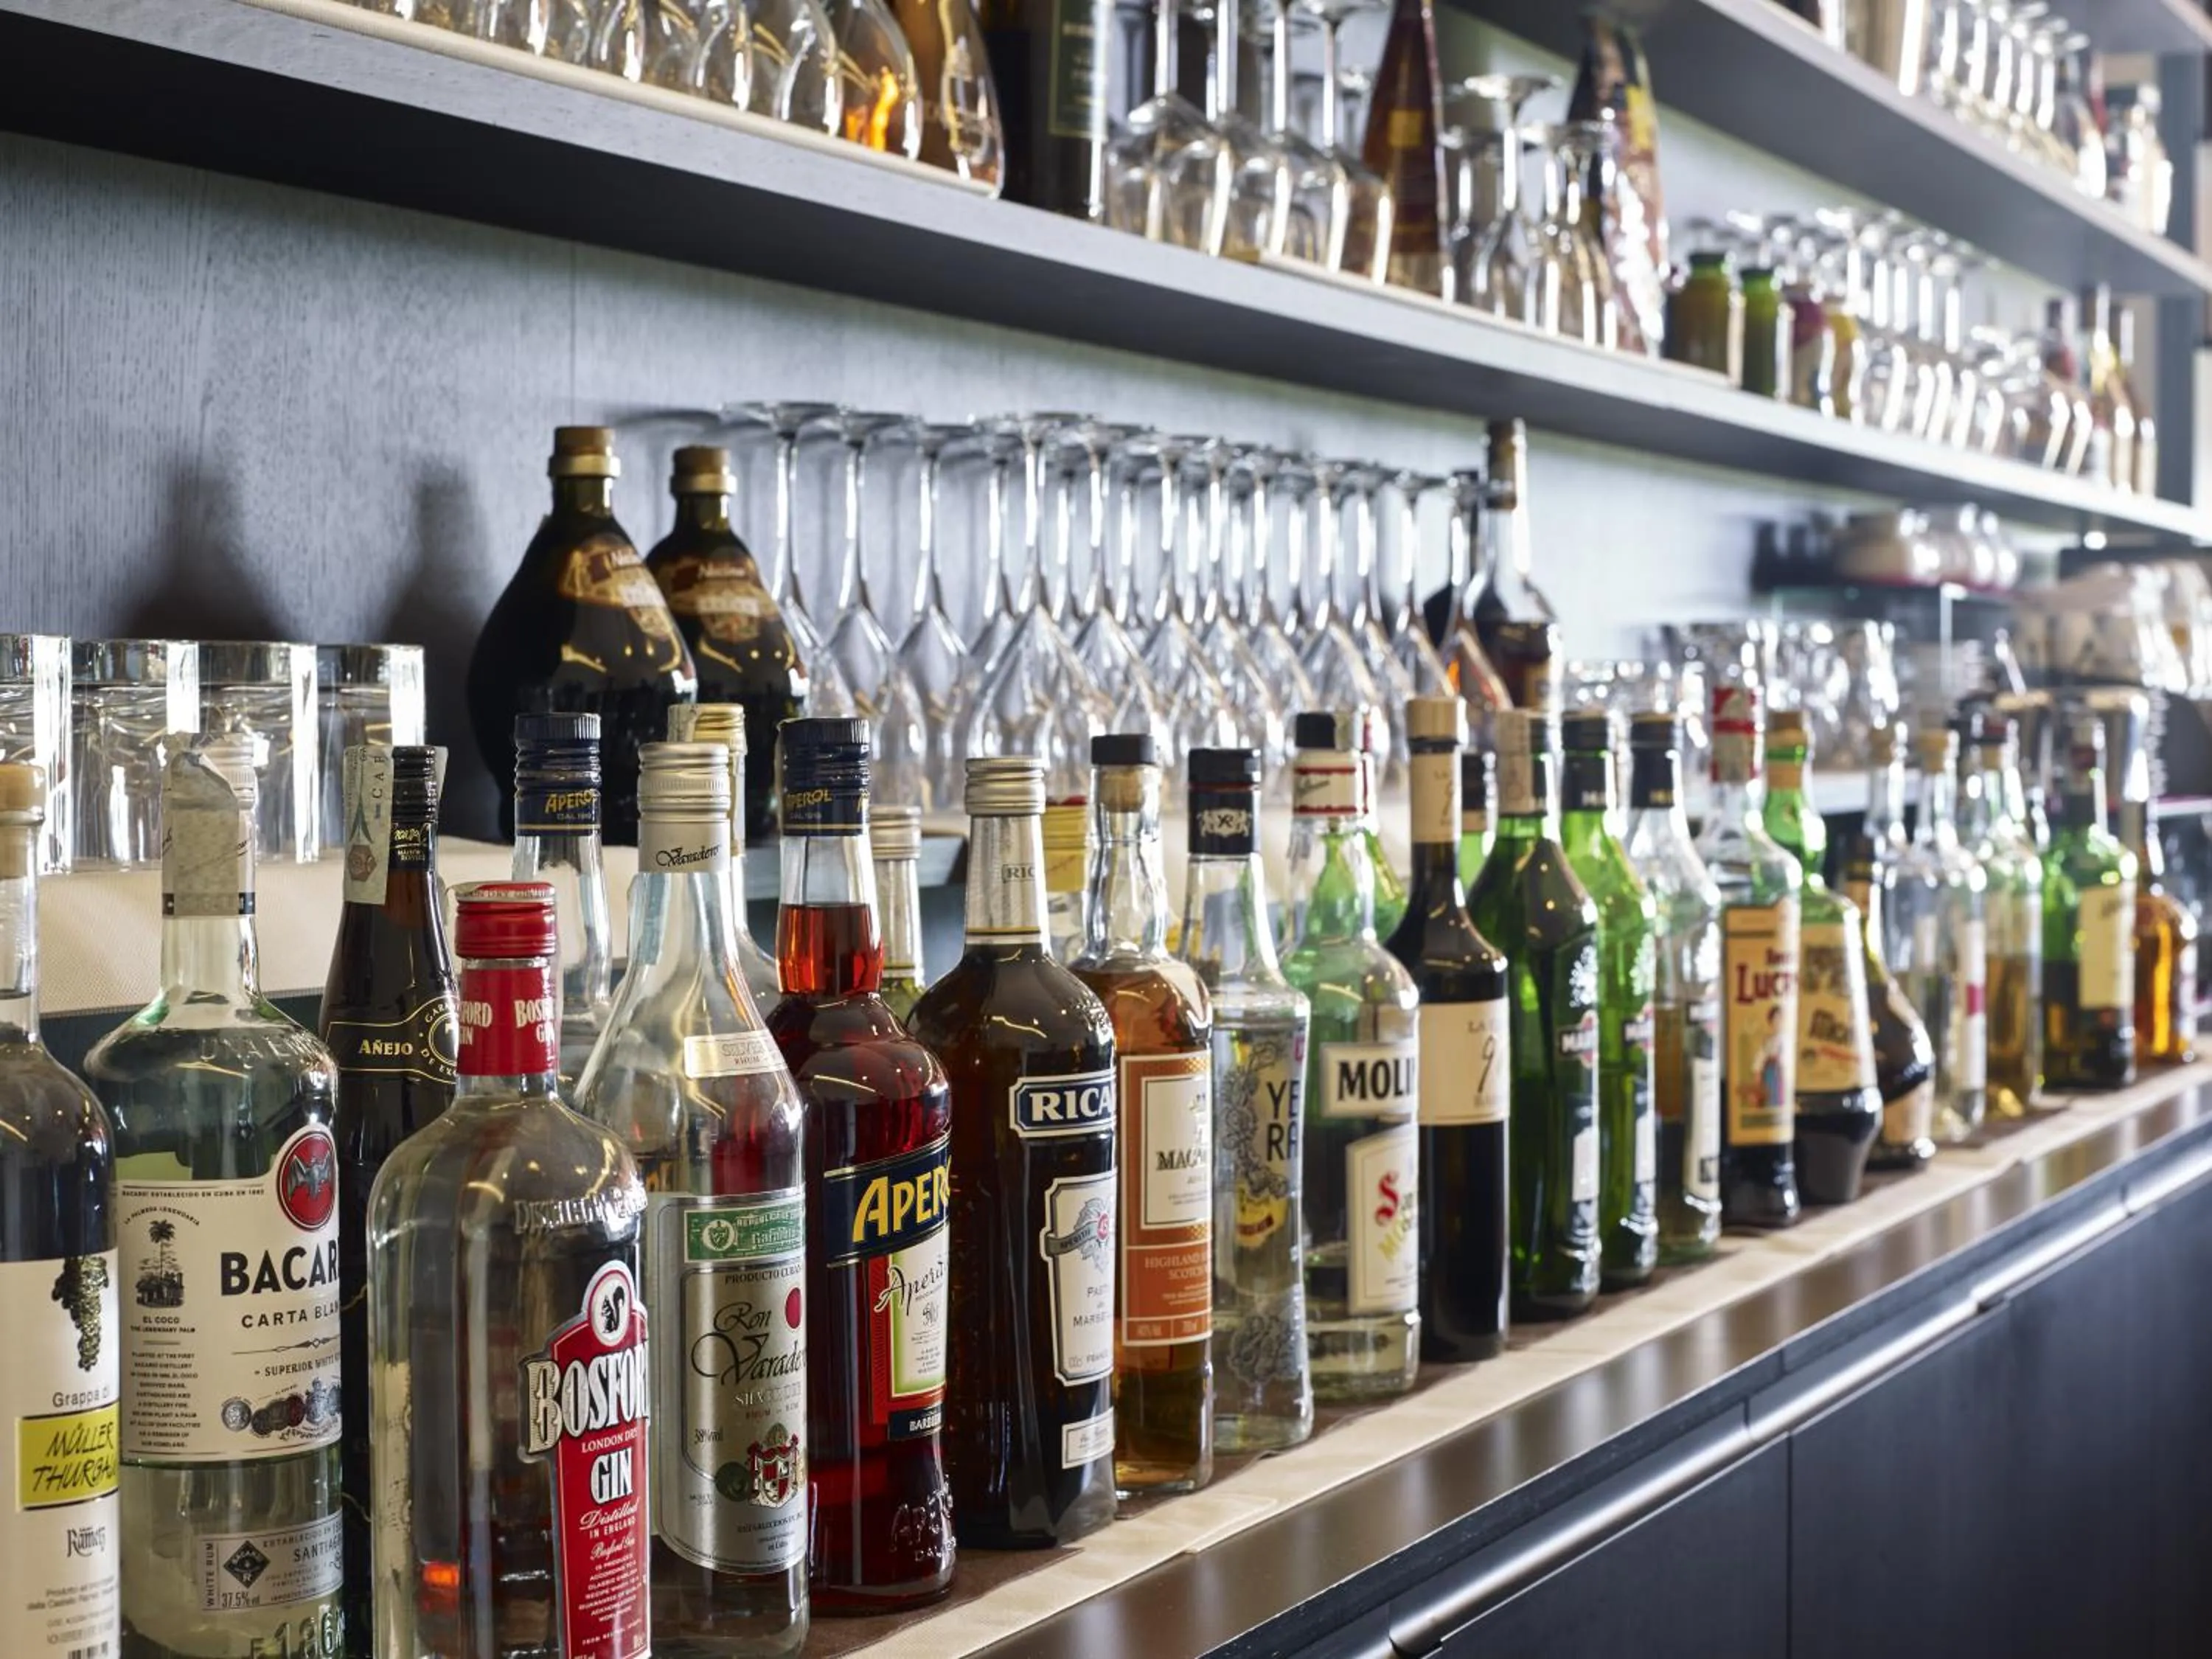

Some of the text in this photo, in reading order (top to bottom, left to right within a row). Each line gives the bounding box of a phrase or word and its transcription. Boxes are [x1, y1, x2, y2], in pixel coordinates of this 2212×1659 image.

[1007, 866, 1036, 878] RIC
[459, 1001, 493, 1028] FORD
[356, 1039, 414, 1056] AÑEJO
[1337, 1057, 1416, 1102] MOLI
[1029, 1085, 1115, 1122] RICA
[220, 1239, 340, 1296] BACAR
[155, 1315, 180, 1325] COCO
[241, 1299, 340, 1329] CARTA BLAN
[714, 1301, 771, 1332] Ron
[265, 1360, 313, 1377] SUPERIOR
[52, 1388, 100, 1408] Grappa
[526, 1339, 650, 1455] BOSFOR
[581, 1433, 623, 1453] LONDON
[591, 1446, 634, 1505] GIN
[578, 1495, 640, 1531] Distilled
